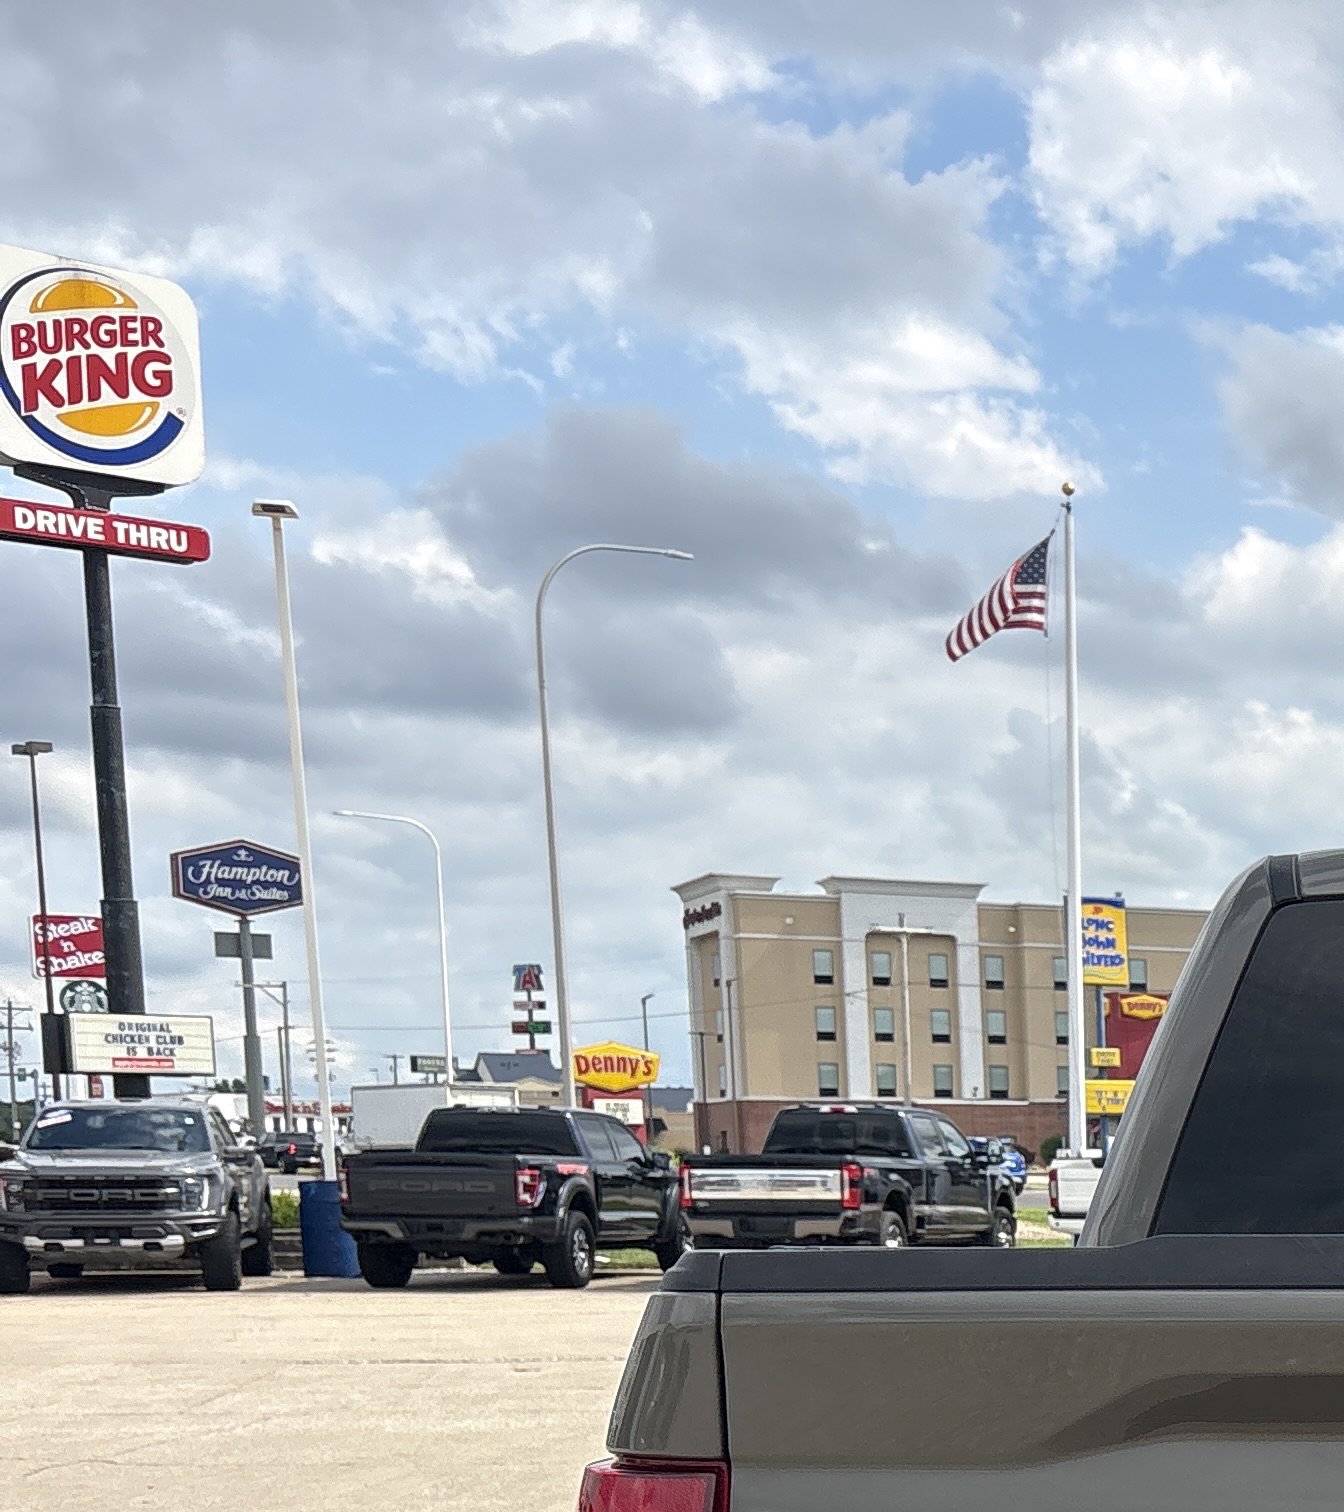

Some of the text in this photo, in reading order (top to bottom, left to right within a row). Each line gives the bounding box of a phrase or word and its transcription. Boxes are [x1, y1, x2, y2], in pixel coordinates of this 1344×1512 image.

[11, 315, 165, 361] BURGER
[21, 350, 173, 413] KING
[13, 506, 188, 552] DRIVE THRU
[187, 860, 299, 886] Hampton
[199, 884, 238, 900] Inn
[247, 885, 289, 900] Suites
[34, 917, 99, 943] Steak
[36, 950, 105, 977] Shake
[104, 1033, 184, 1046] CHICKEN CLUB
[118, 1022, 172, 1033] ORIGINAL
[126, 1046, 175, 1057] IS BACK
[575, 1054, 653, 1079] Denny's
[37, 1188, 166, 1201] FORD
[368, 1181, 496, 1193] FORD
